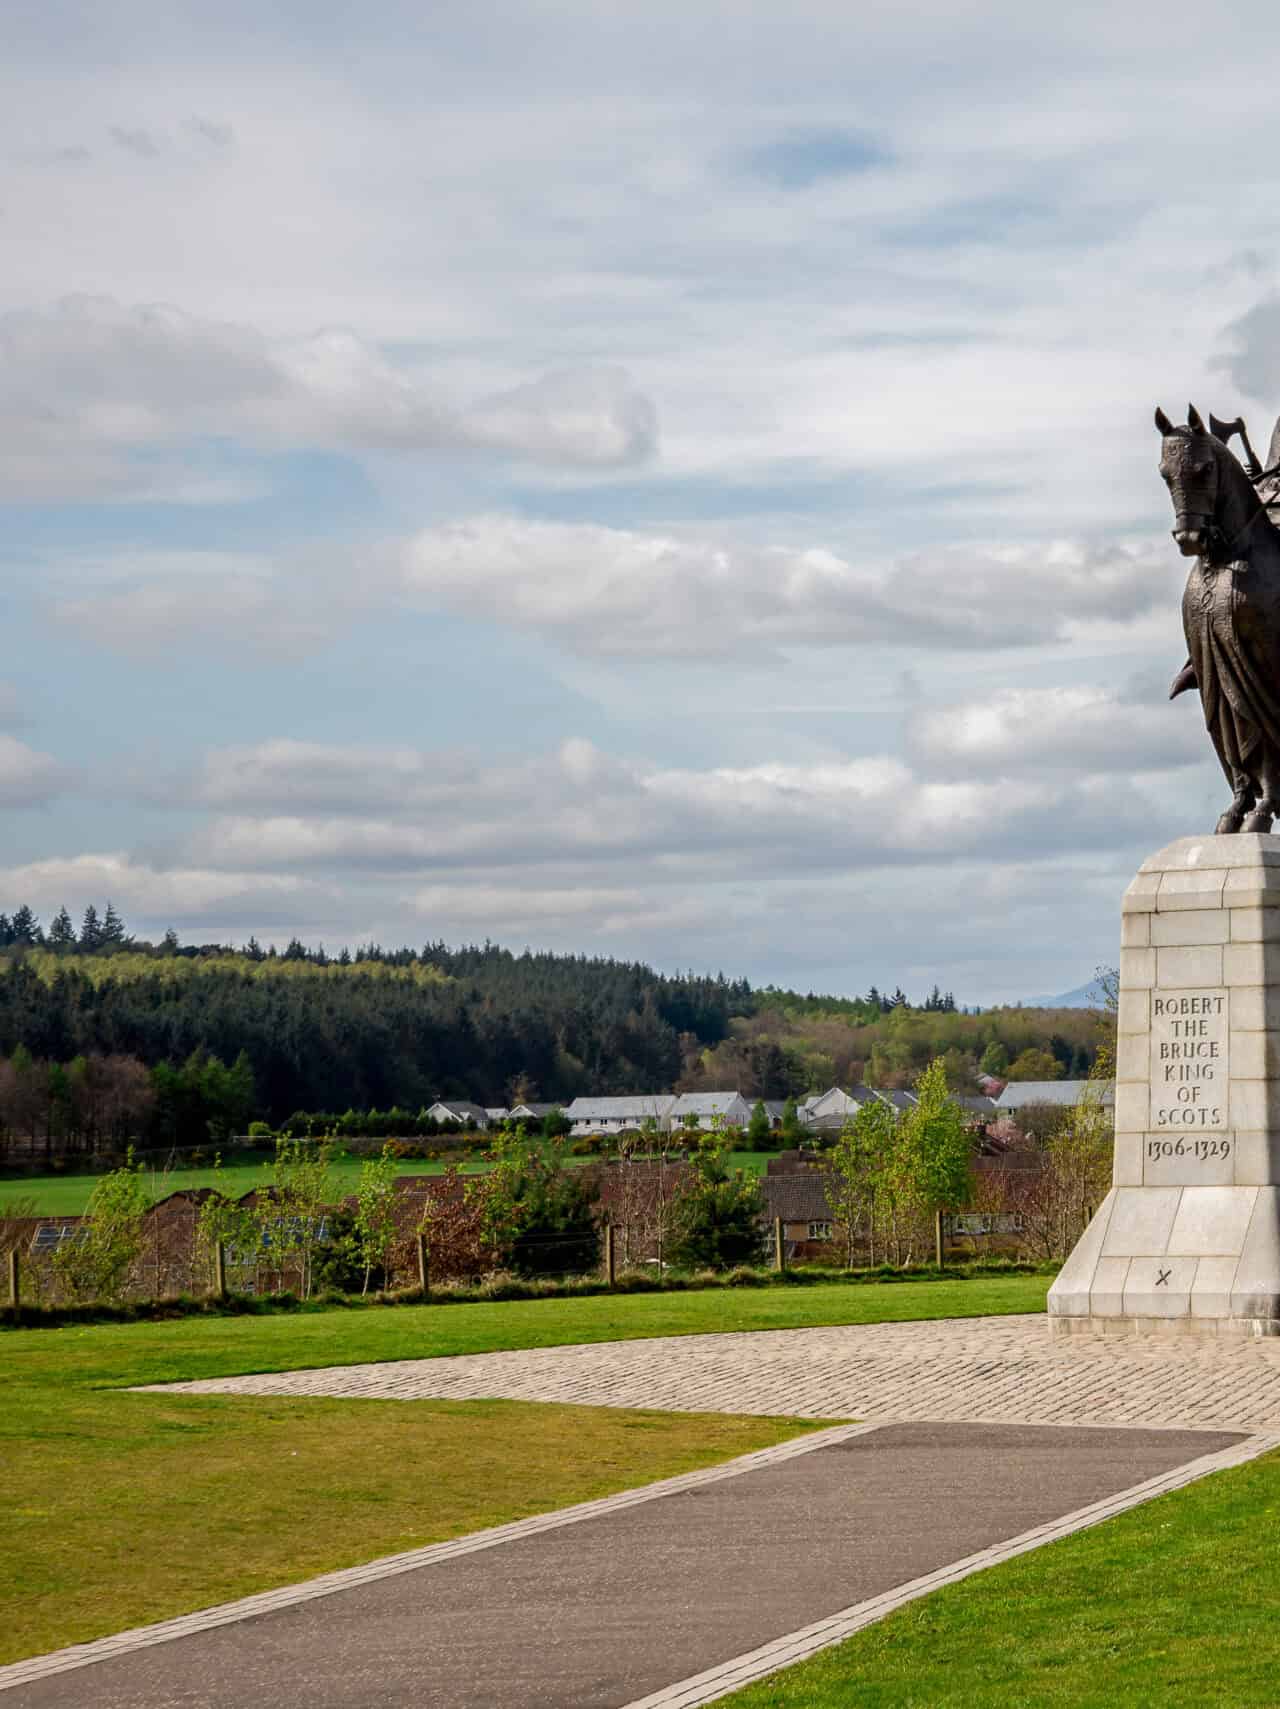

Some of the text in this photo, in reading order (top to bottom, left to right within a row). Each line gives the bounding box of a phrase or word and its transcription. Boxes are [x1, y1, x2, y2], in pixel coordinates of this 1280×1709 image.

[1154, 997, 1225, 1016] ROBERT
[1171, 1019, 1208, 1037] THE
[1160, 1041, 1219, 1060] BRUCE
[1165, 1063, 1214, 1082] KING
[1177, 1086, 1201, 1103] OF
[1158, 1108, 1221, 1126] SCOTS
[1148, 1136, 1231, 1162] 1306-1329
